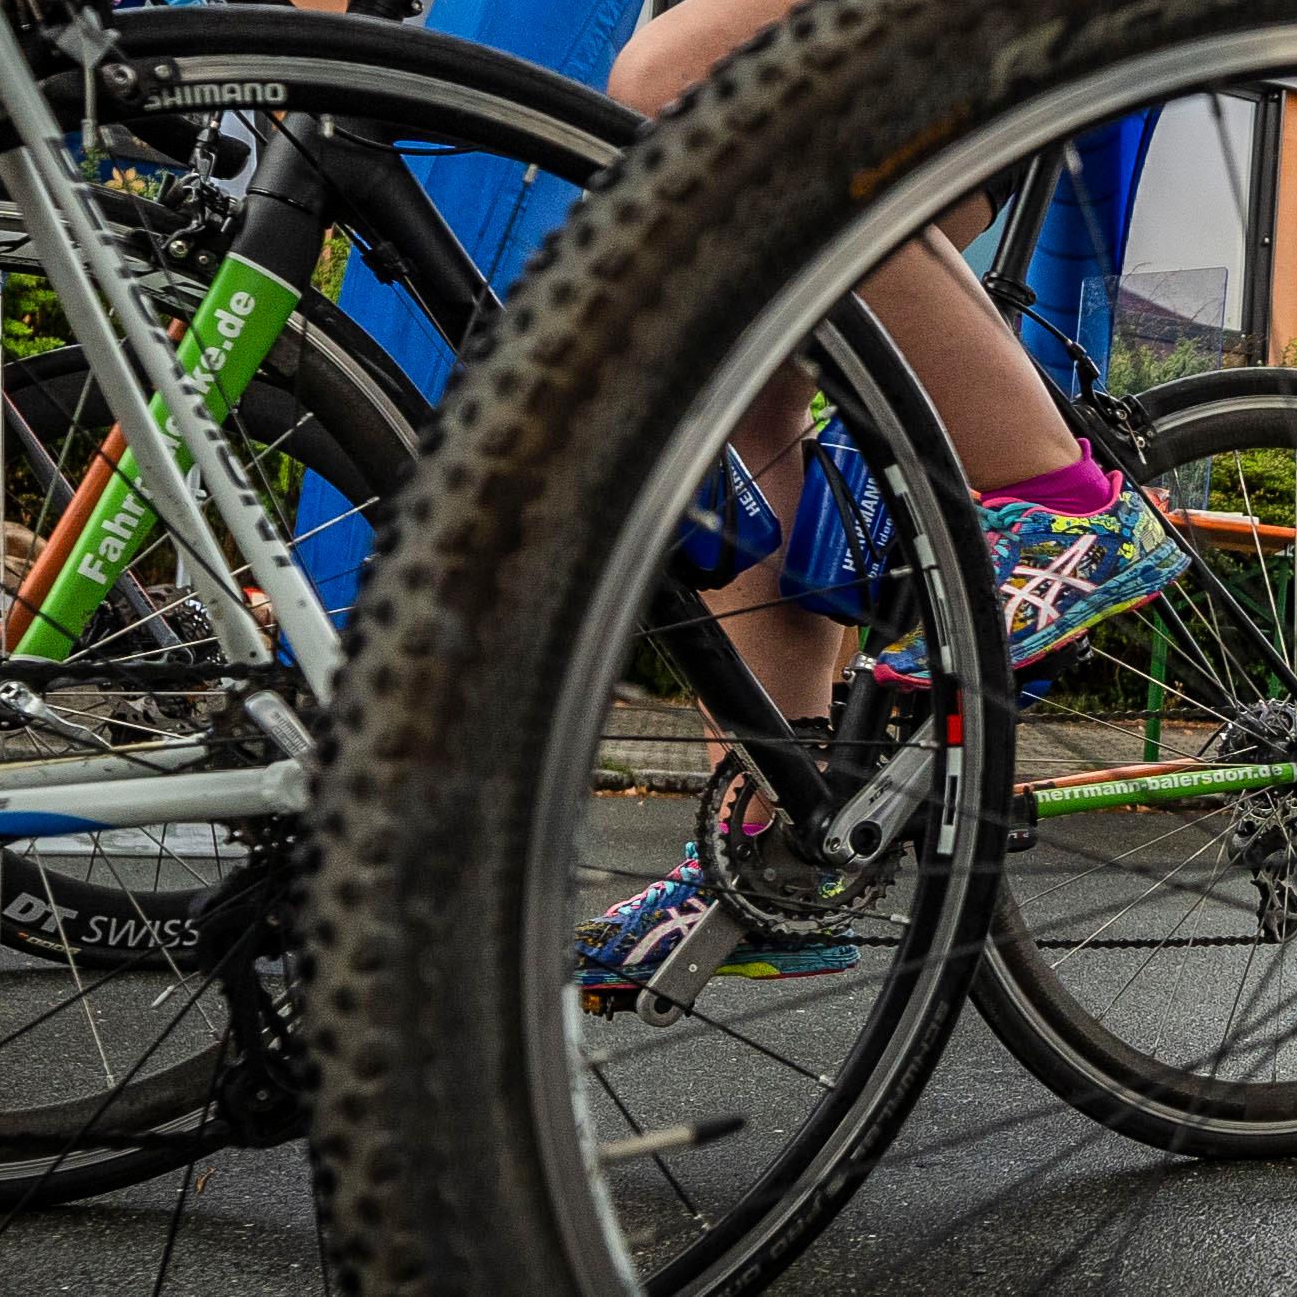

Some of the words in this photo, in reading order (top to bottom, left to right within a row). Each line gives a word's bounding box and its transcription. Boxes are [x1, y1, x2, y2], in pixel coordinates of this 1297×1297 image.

[1038, 763, 1283, 803] herrmann-baiersdorf.de
[2, 891, 79, 934] DT
[81, 916, 200, 948] SWISS
